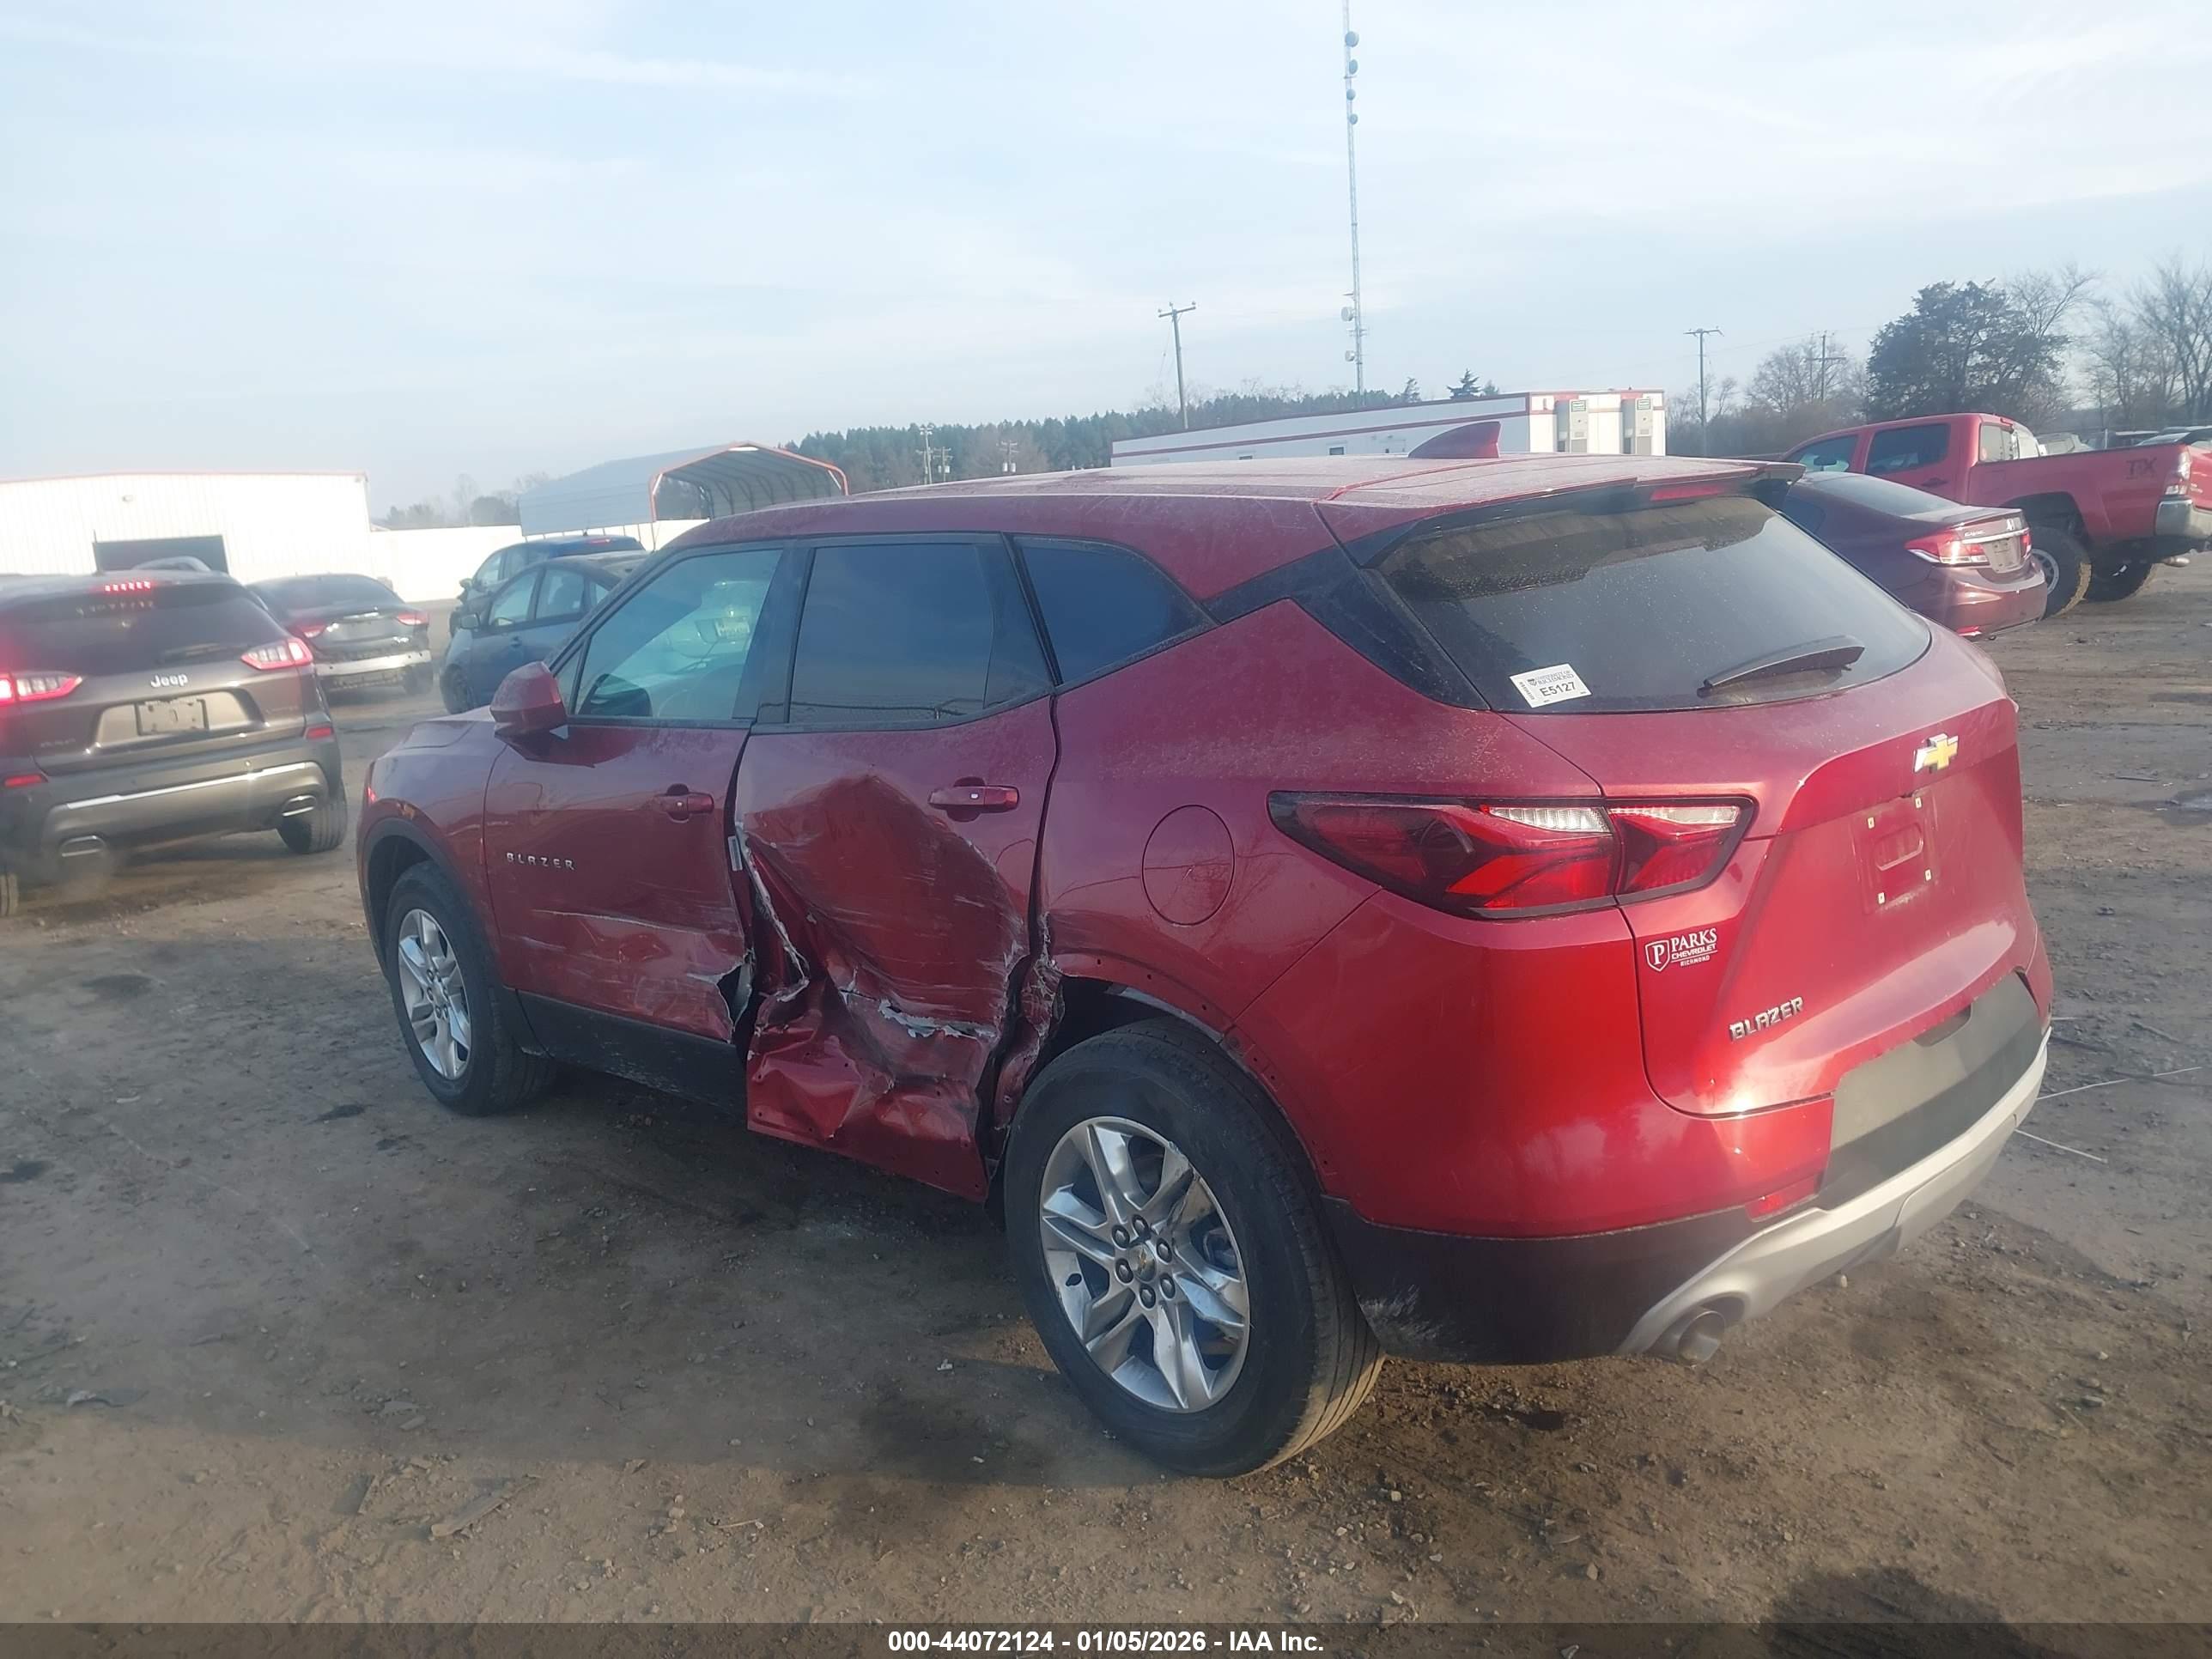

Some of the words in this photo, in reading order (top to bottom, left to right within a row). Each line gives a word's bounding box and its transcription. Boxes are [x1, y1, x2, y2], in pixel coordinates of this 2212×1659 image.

[150, 673, 189, 688] Jeep
[1539, 681, 1577, 697] E5127
[506, 852, 574, 871] BLAZER
[1670, 927, 1717, 952] PARKS
[1652, 944, 1665, 965] P
[1671, 943, 1717, 960] CHEVROLET
[1680, 954, 1711, 967] RICHMOND
[1729, 996, 1803, 1042] BLAZER
